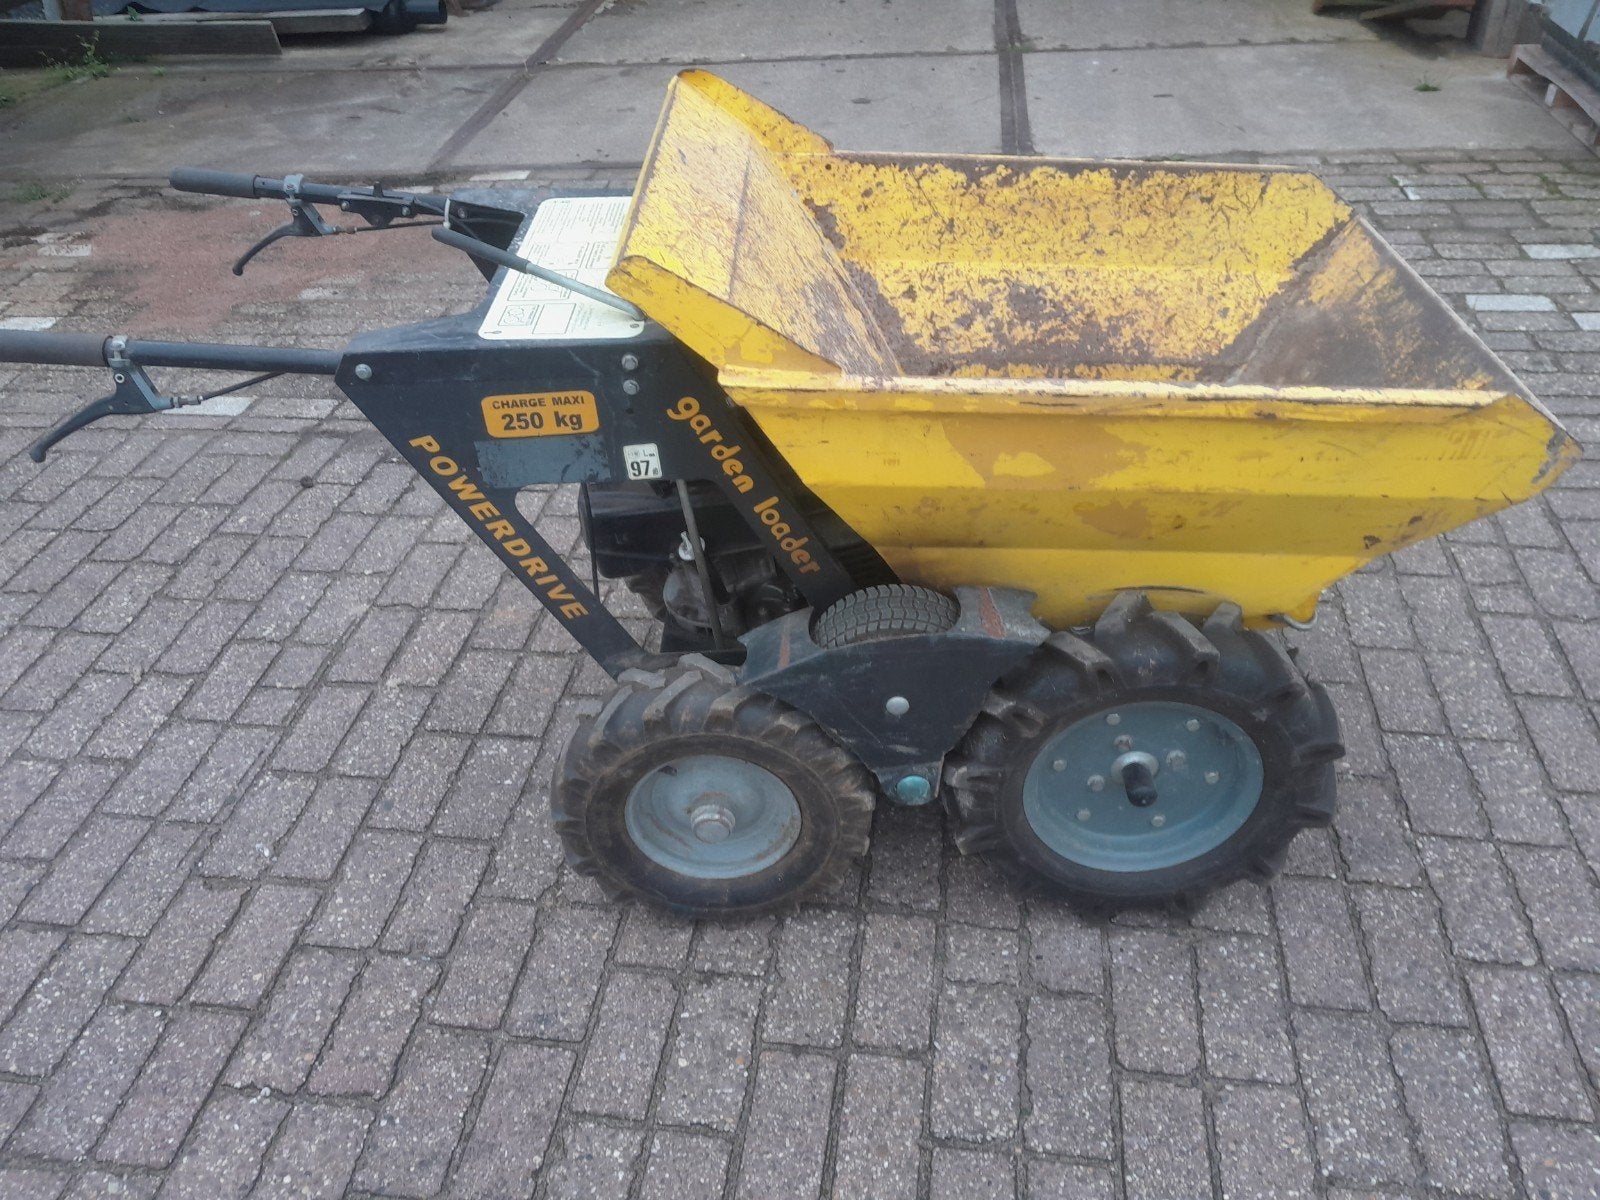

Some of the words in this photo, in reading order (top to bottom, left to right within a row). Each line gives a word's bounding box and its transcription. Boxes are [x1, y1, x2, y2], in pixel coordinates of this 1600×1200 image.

[492, 398, 546, 410] CHARGE
[551, 395, 585, 406] MAXI
[501, 411, 544, 431] 250
[553, 410, 583, 431] kg
[630, 460, 650, 477] 97
[667, 396, 754, 494] garden
[753, 496, 820, 574] loader
[408, 434, 589, 620] POWERDRIVE
